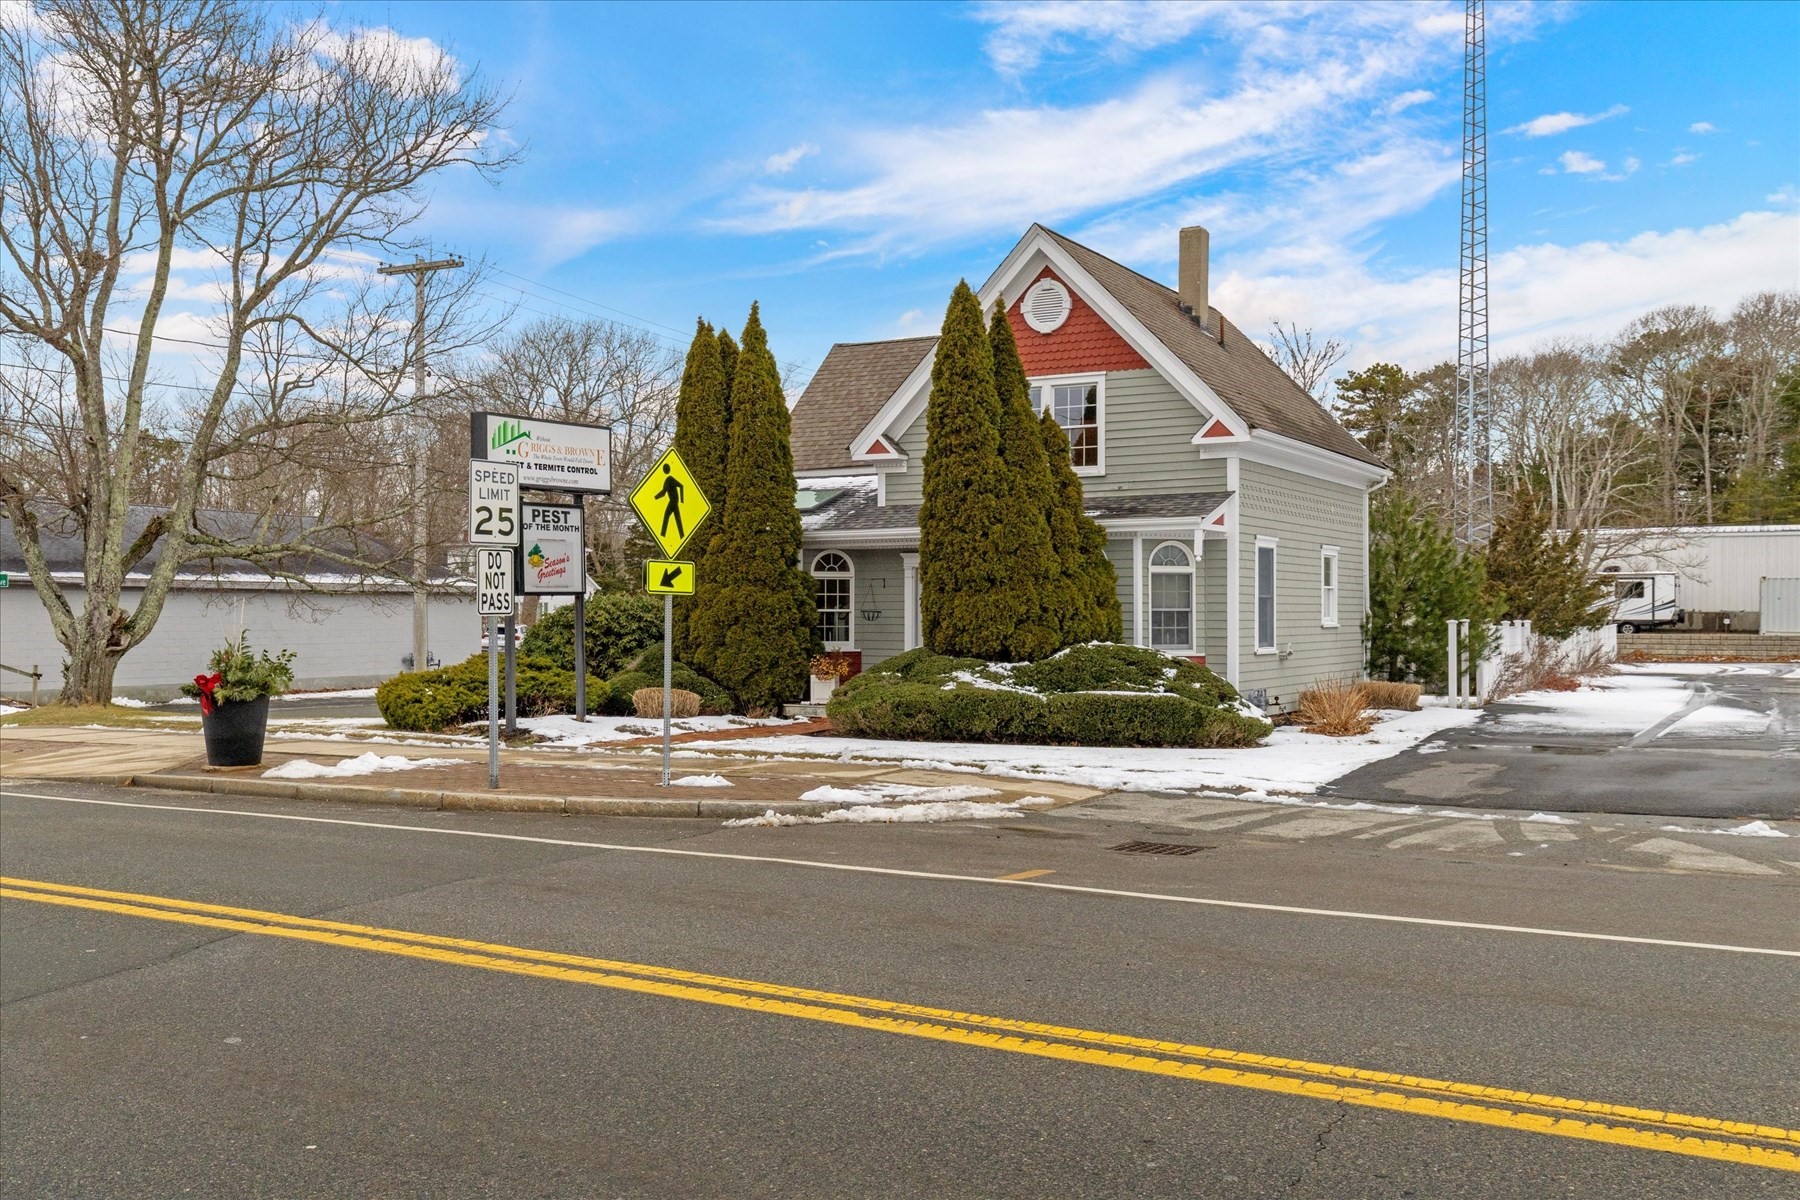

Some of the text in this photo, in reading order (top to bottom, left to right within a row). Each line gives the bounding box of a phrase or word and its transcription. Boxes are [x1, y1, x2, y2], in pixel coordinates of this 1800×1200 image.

[518, 441, 605, 466] GRIGGS & BROWNE
[527, 462, 532, 470] &
[534, 463, 565, 472] TERMITE
[567, 466, 598, 475] CONTROL
[474, 470, 515, 485] SPEED
[479, 488, 510, 501] LIMIT
[475, 506, 514, 537] 25
[532, 509, 570, 524] PEST
[487, 552, 502, 570] DO
[544, 553, 571, 569] Season's
[485, 572, 506, 590] NOT
[537, 566, 566, 583] Greetings
[481, 593, 510, 611] PASS
